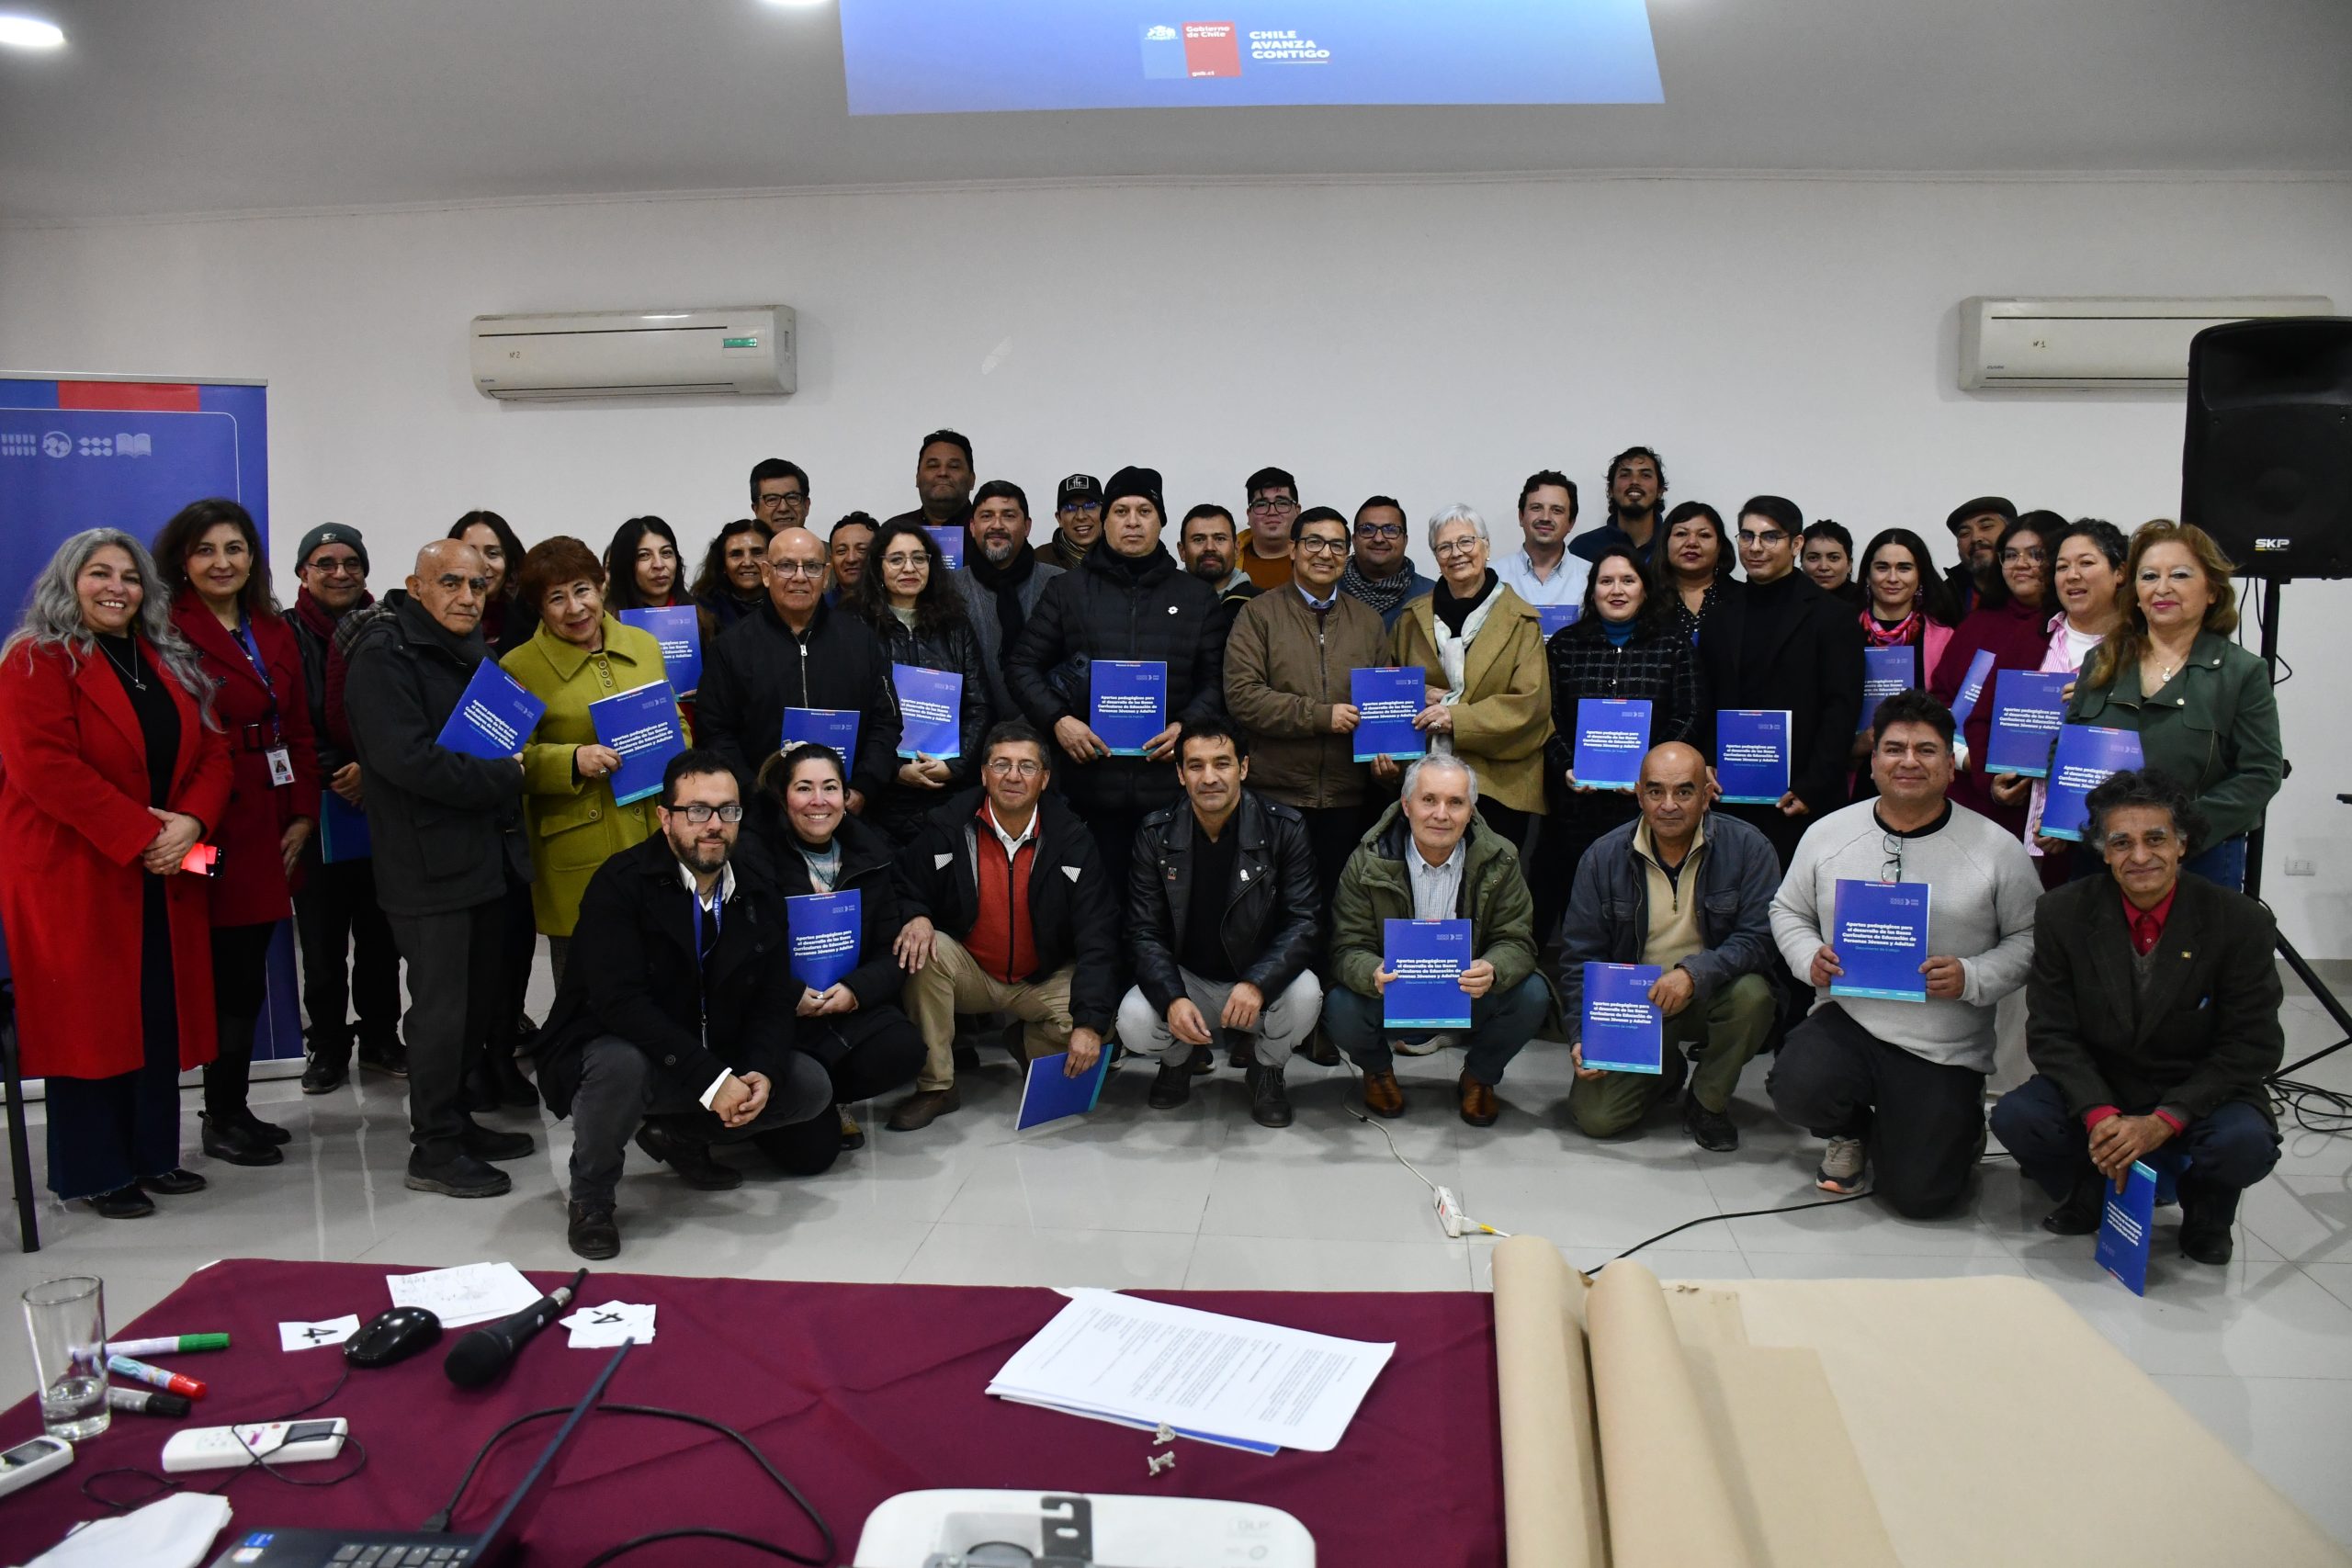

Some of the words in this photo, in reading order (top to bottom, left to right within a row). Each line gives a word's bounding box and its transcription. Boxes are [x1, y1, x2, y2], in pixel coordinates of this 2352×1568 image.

[1250, 30, 1296, 39] CHILE
[1250, 40, 1317, 50] AVANZA
[1252, 50, 1329, 59] CONTIGO
[2255, 538, 2290, 547] SKP
